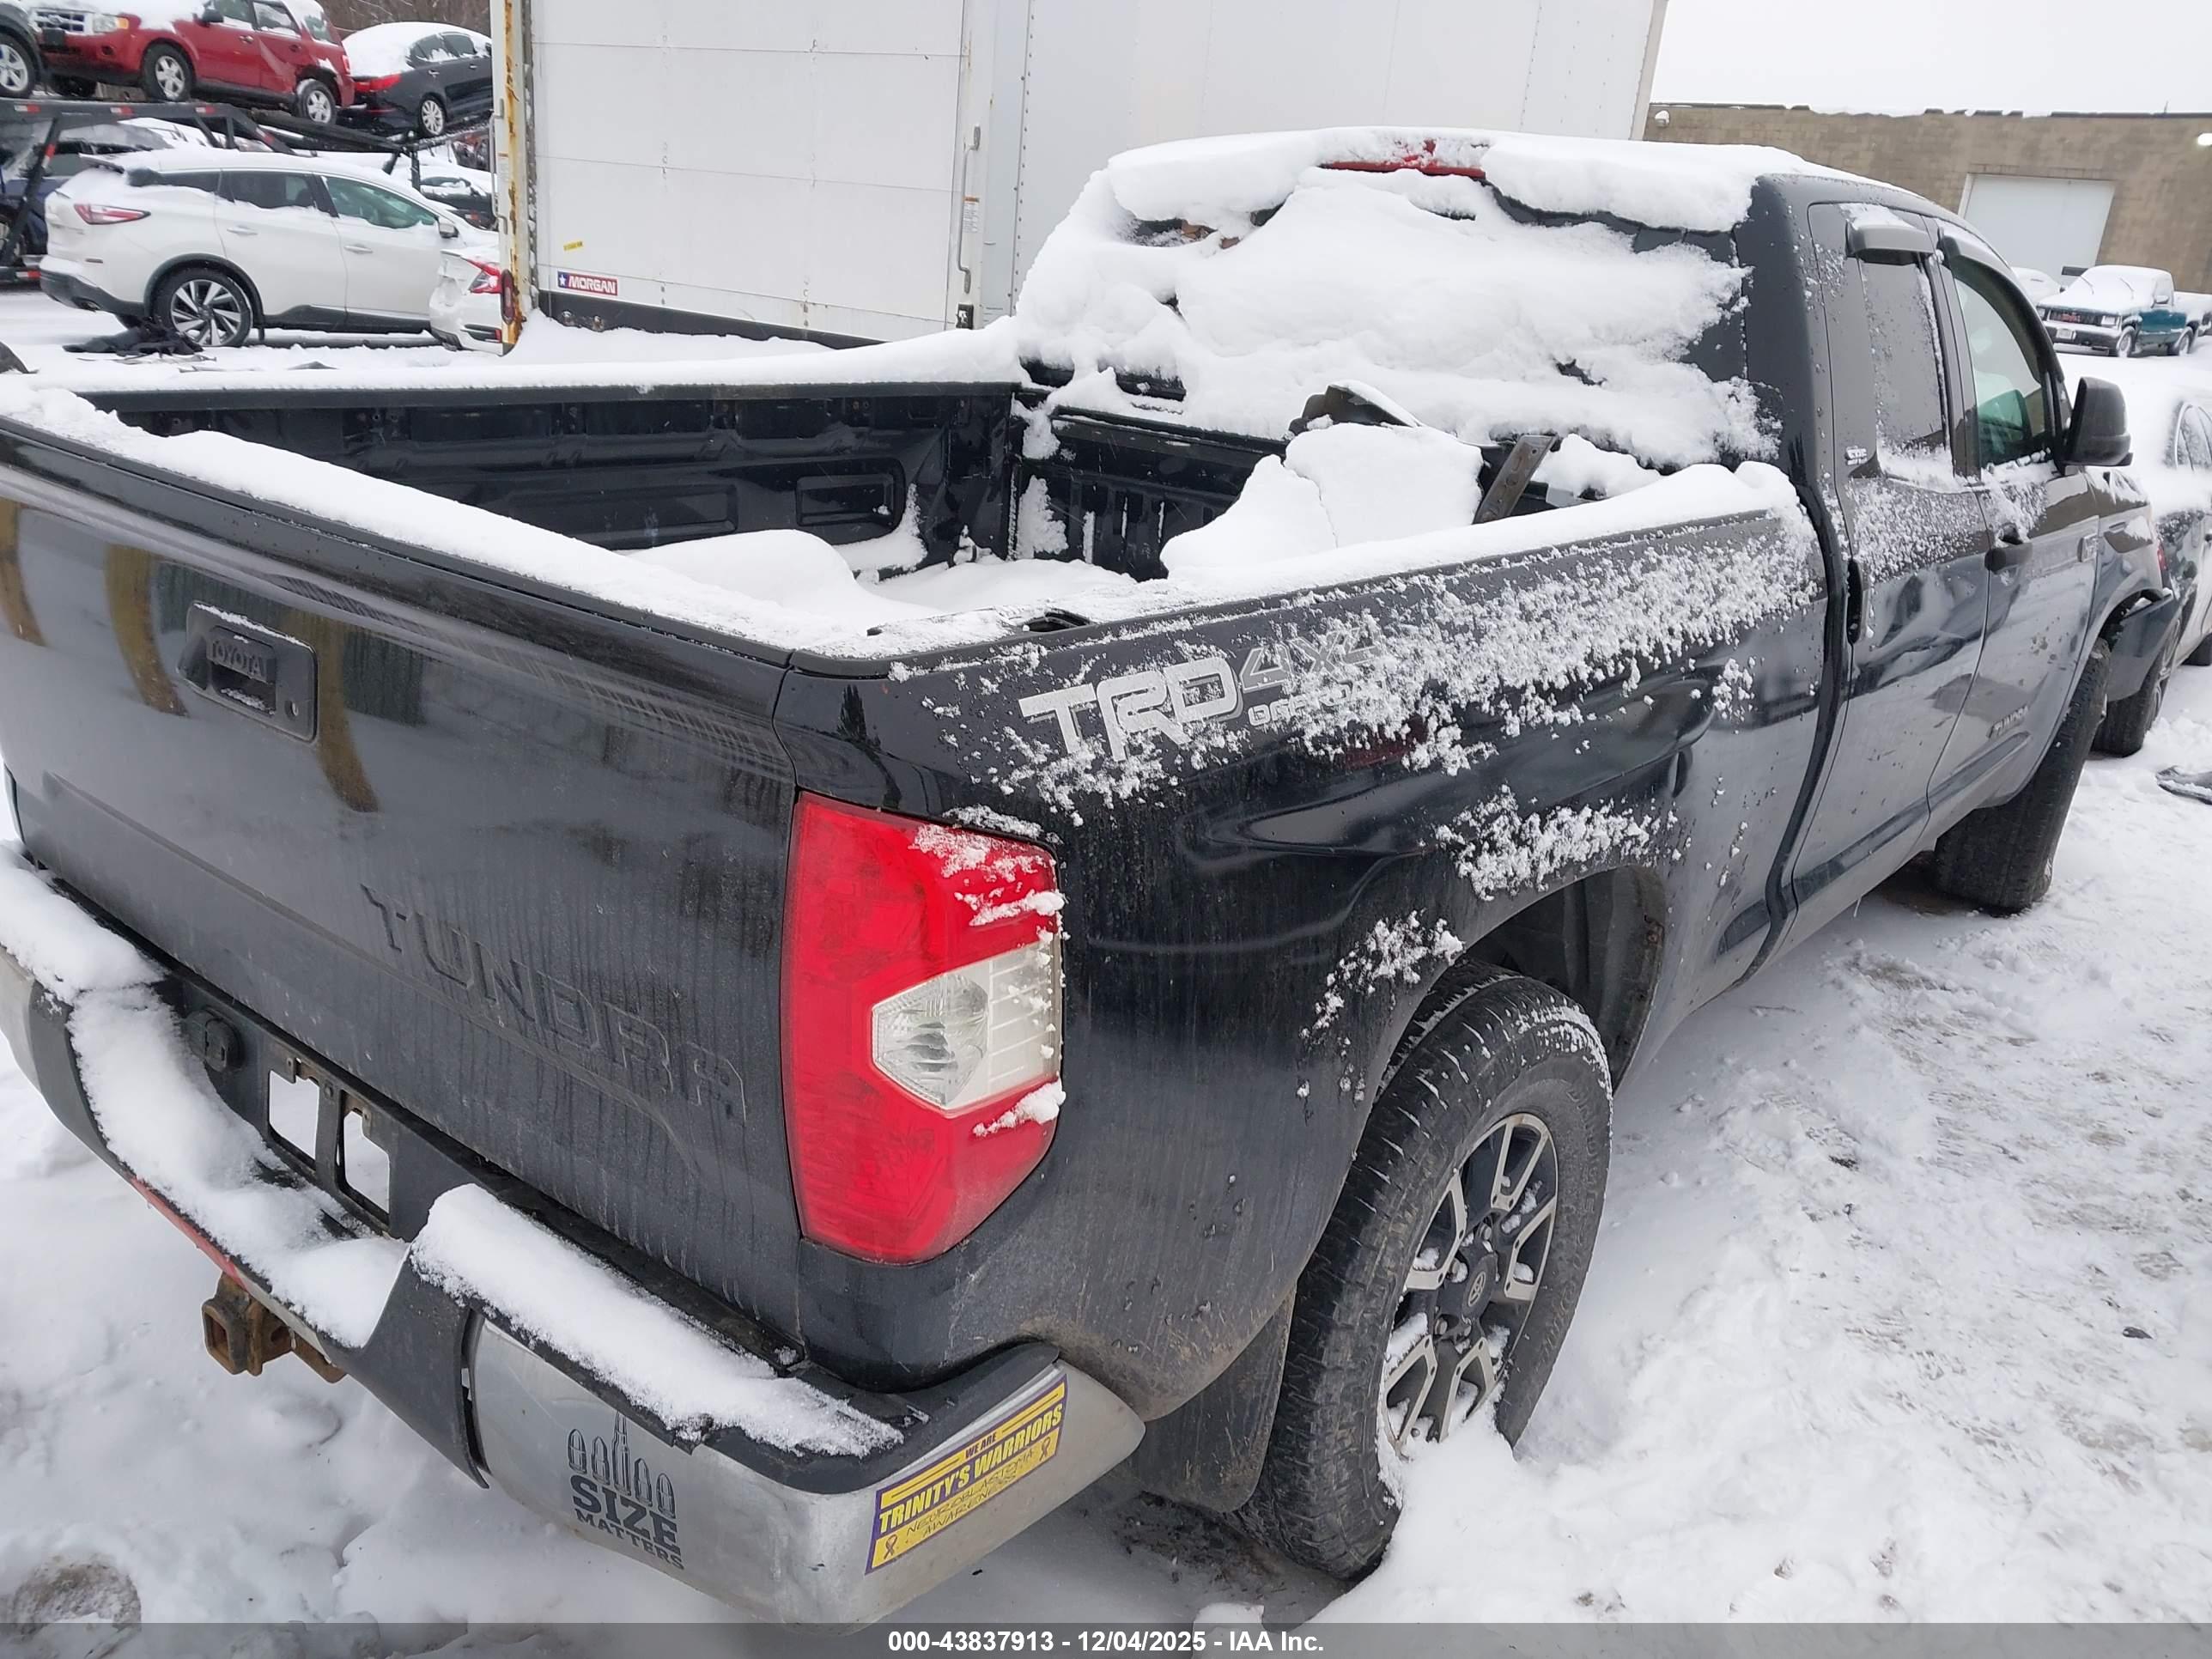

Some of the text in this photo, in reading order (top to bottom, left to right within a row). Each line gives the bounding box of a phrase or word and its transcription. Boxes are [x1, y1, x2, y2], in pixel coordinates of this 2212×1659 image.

[568, 275, 617, 294] MORGAN
[211, 640, 263, 678] TOYOTA
[1018, 656, 1243, 763] TRD
[879, 1403, 1063, 1534] TRINITY'S WARRIORS
[964, 1431, 998, 1458] WE ARE
[570, 1474, 682, 1556] SIZE
[574, 1508, 684, 1571] MATTERS
